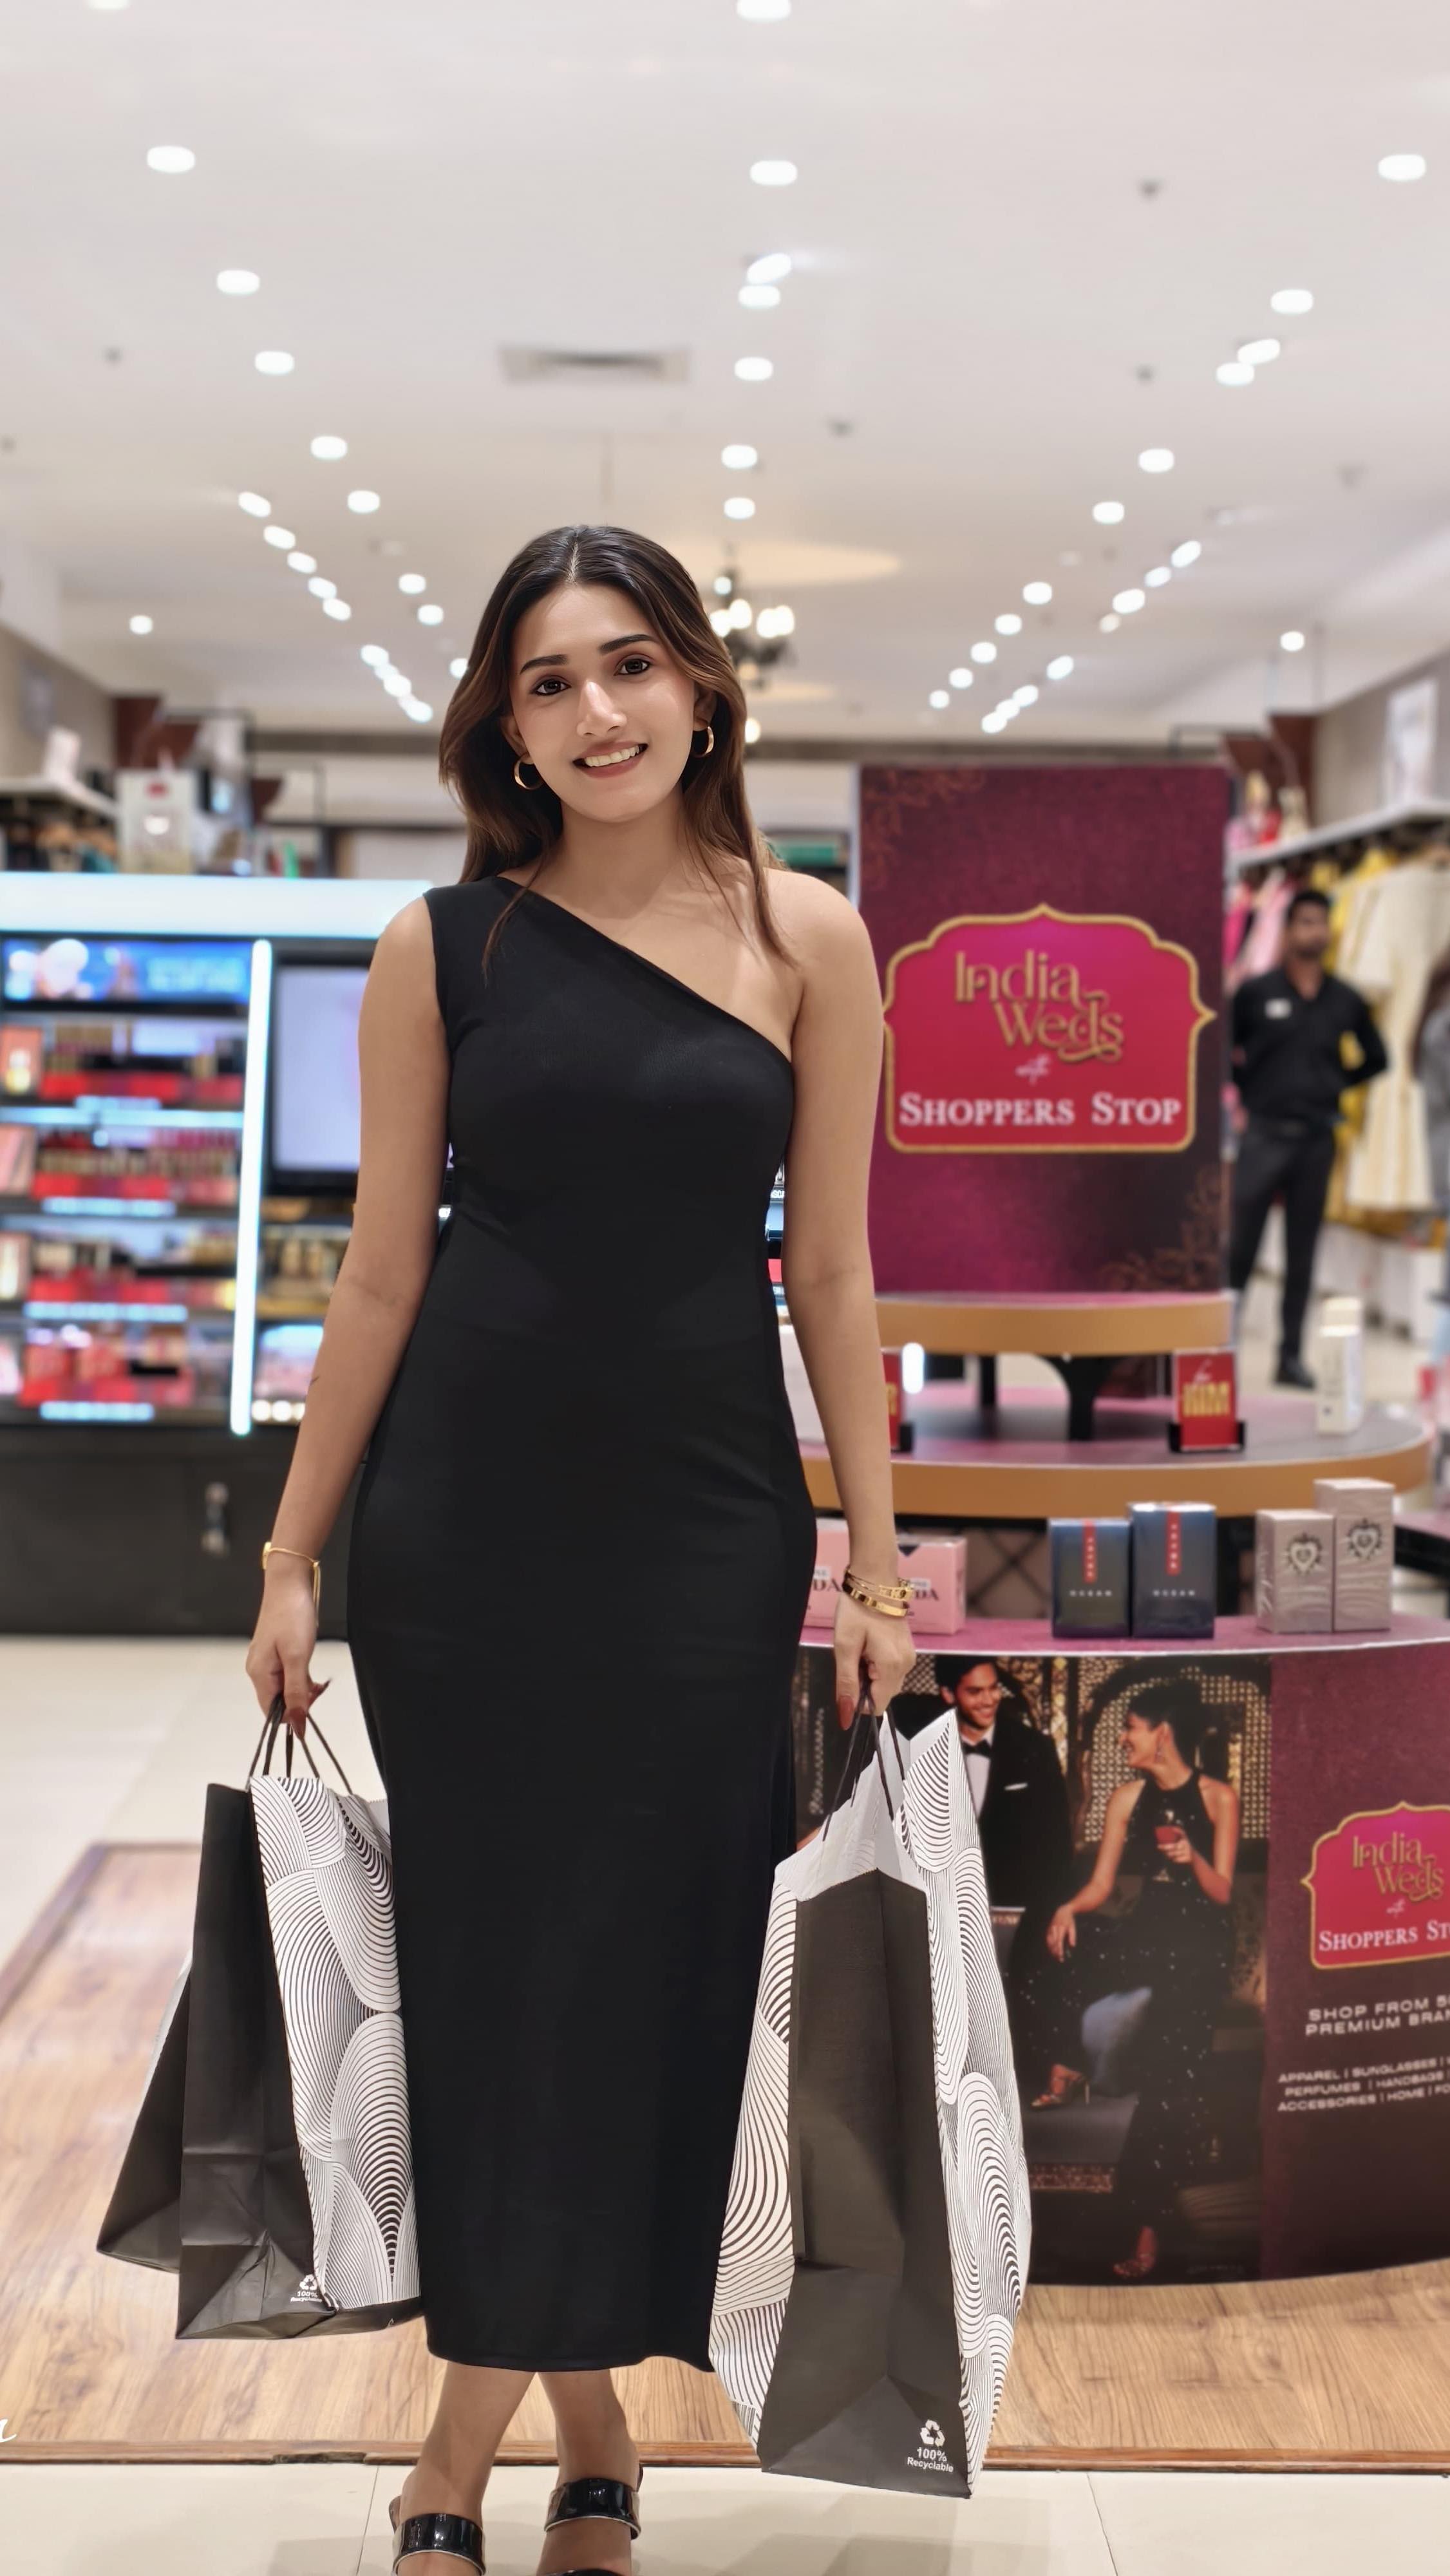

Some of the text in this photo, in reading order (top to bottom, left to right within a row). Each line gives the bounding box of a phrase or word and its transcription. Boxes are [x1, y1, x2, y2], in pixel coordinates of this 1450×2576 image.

[956, 949, 1083, 1009] India
[993, 990, 1124, 1064] Weds
[900, 1092, 1181, 1126] SHOPPERS STOP
[1353, 1831, 1423, 1870] India
[1374, 1853, 1444, 1902] Weds
[1319, 1926, 1418, 1952] SHOPPERS
[1308, 2004, 1368, 2022] SHOP
[1375, 1996, 1429, 2016] FROM
[1305, 2015, 1400, 2037] PREMIUM
[1278, 2069, 1341, 2083] APPAREL
[1352, 2057, 1437, 2078] SUNGLASSES
[1285, 2081, 1361, 2098] PERFUMES
[1376, 2070, 1444, 2088] HANDBAGS
[1277, 2093, 1377, 2112] ACCESSORIES
[1387, 2086, 1425, 2102] HOME
[907, 2456, 954, 2473] Recyclable
[917, 2447, 948, 2463] 100%
